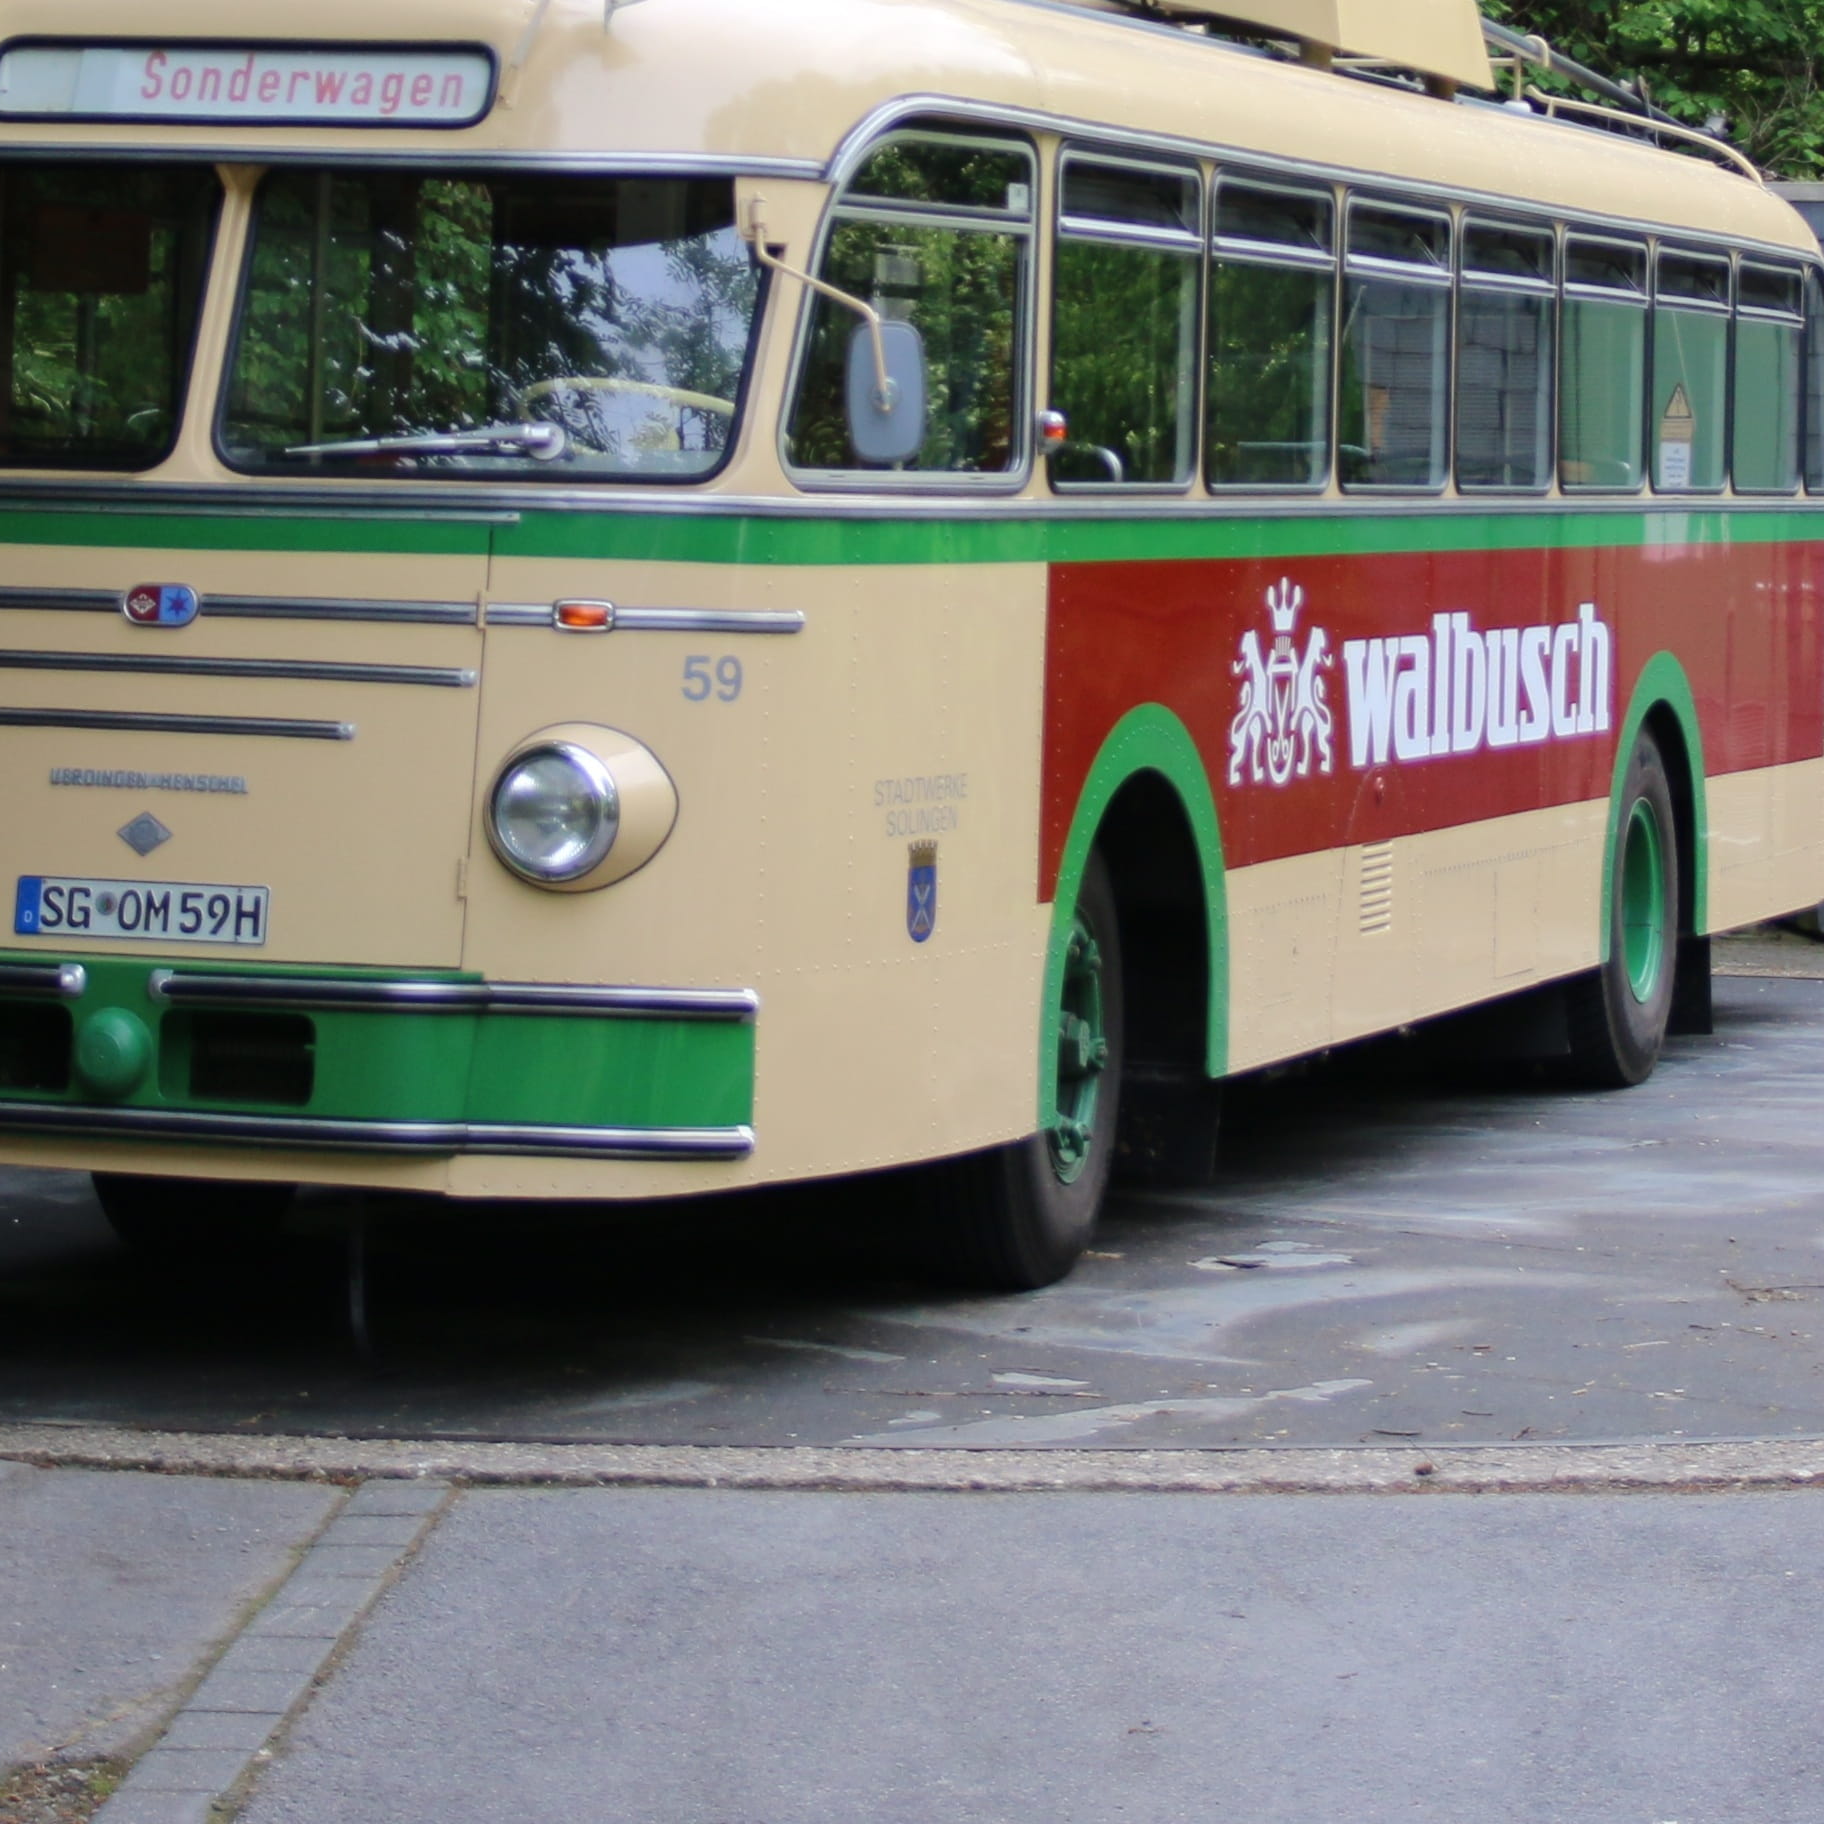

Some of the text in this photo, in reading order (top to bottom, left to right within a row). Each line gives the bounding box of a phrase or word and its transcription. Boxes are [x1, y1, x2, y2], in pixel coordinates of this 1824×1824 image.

[140, 50, 464, 115] Sonderwagen
[682, 655, 743, 702] 59
[874, 772, 968, 807] STADTWERKE
[886, 805, 959, 837] SOLINGEN
[40, 886, 262, 937] SG OM 59H
